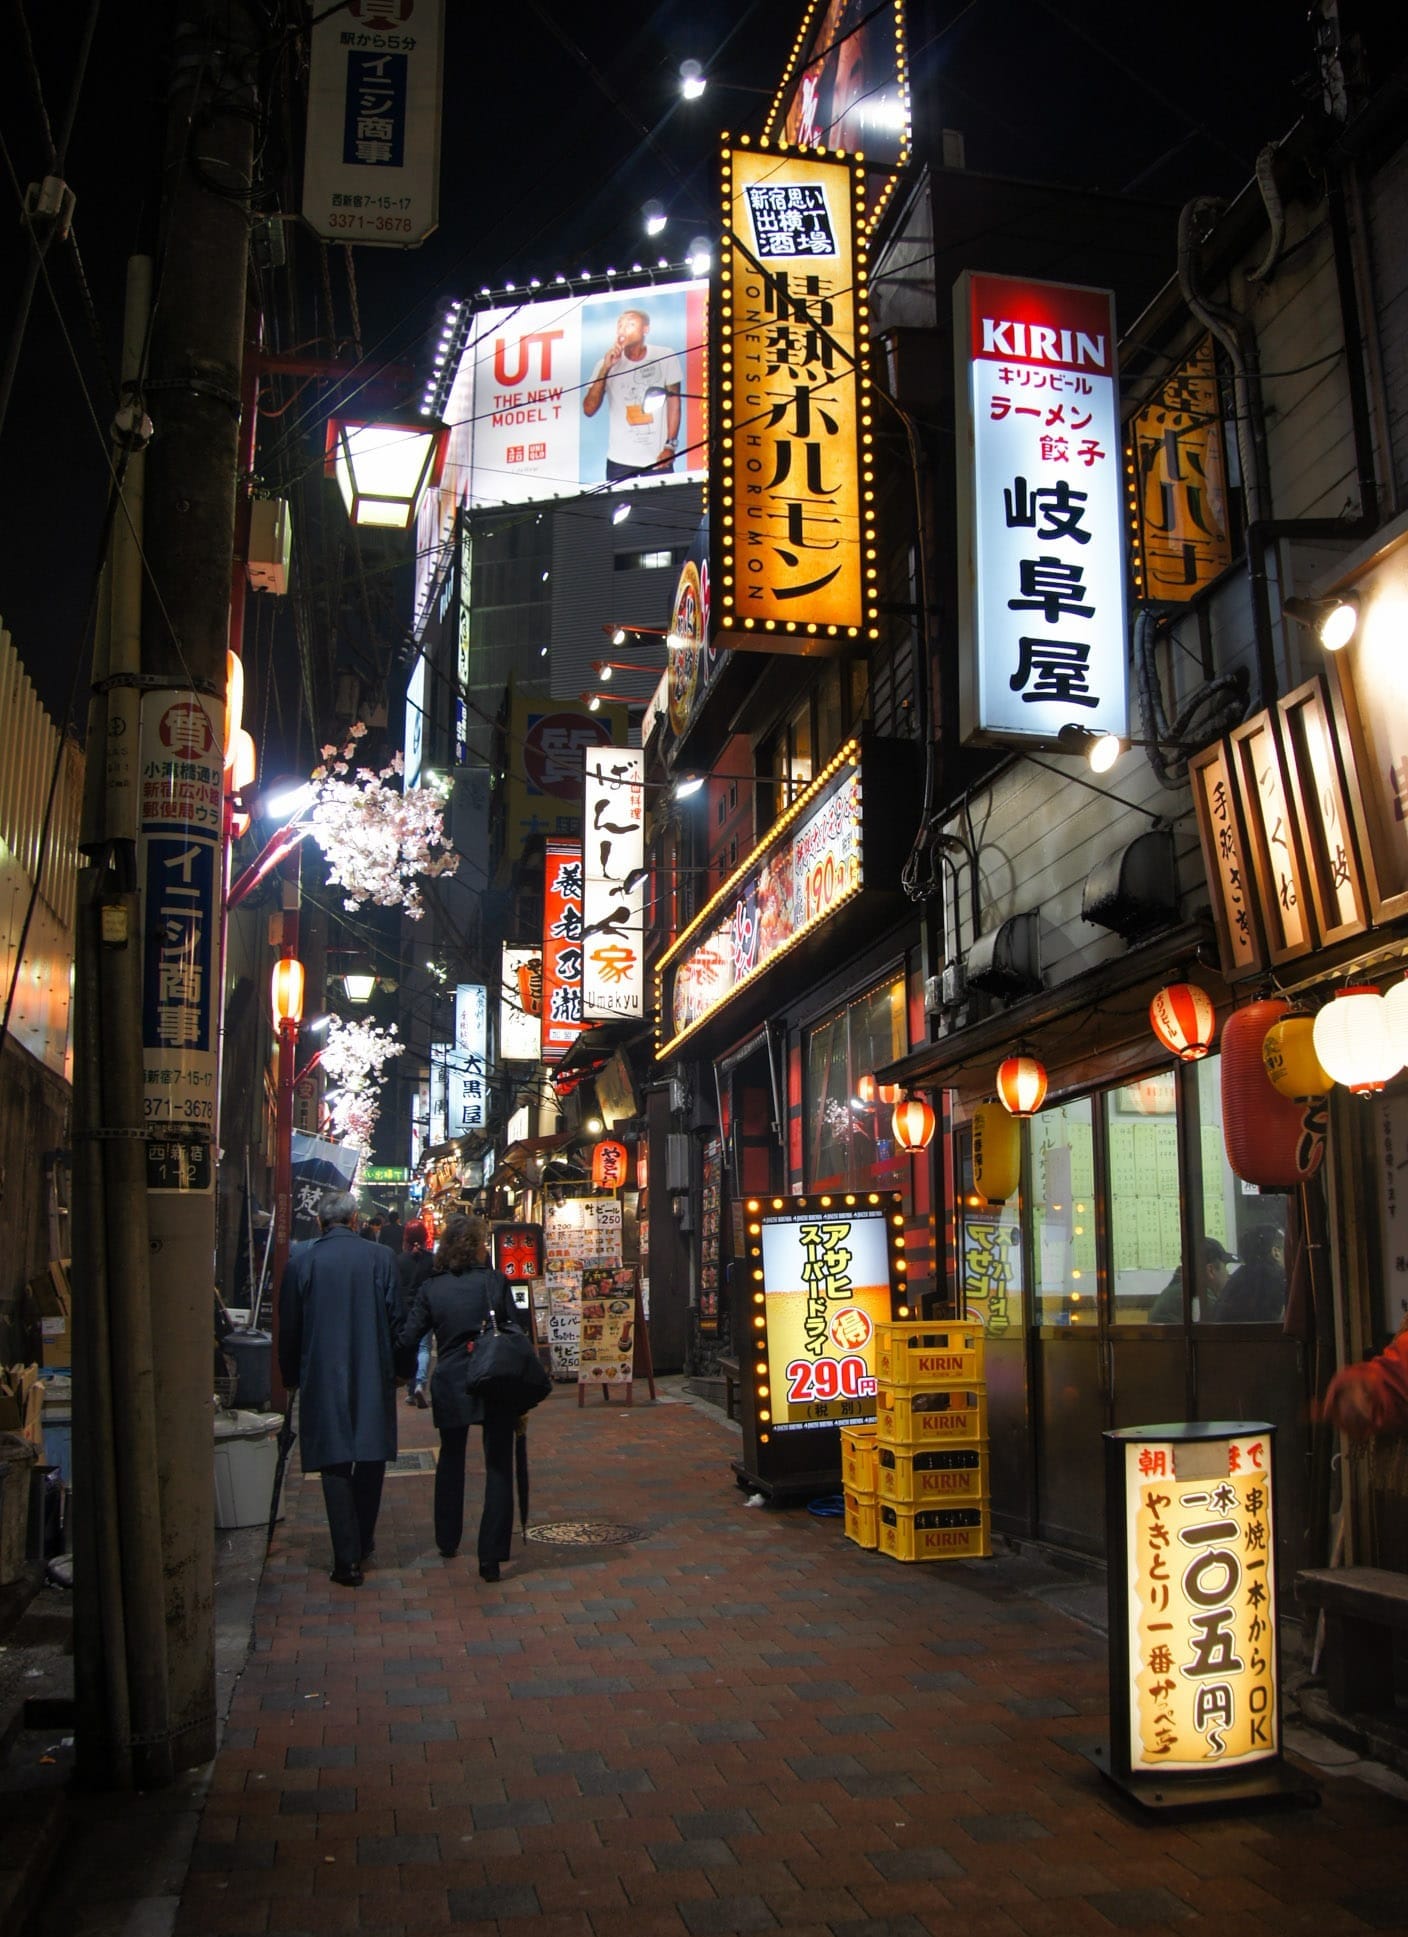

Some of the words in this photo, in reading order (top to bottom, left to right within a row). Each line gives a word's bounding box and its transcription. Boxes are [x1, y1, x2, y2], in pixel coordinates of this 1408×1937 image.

[340, 31, 417, 50] 駅から5分
[354, 54, 395, 164] イニシ商事
[331, 193, 411, 211] 西新宿7-15-17
[749, 188, 823, 210] 新宿思い
[328, 213, 412, 233] 3371-3678
[756, 208, 826, 233] 出横丁
[759, 232, 832, 254] 酒場
[493, 329, 564, 387] UT
[981, 317, 1106, 368] KIRIN
[998, 366, 1093, 396] キリンビール
[493, 393, 522, 409] THE
[527, 386, 564, 404] NEW
[990, 395, 1093, 430] ラーメン
[492, 408, 547, 428] MODEL
[553, 406, 562, 420] T
[529, 443, 545, 453] UNI
[764, 271, 843, 600] 情熱ホルモン
[1039, 434, 1106, 467] 餃子
[529, 452, 545, 461] QLO
[746, 435, 763, 599] HORUMON
[1003, 476, 1100, 709] 岐阜屋
[165, 708, 213, 753] 質
[156, 845, 204, 1047] イニシ商事
[587, 991, 639, 1010] Umakyu
[461, 1054, 482, 1124] 大黒屋
[820, 1222, 852, 1300] アサヒ
[799, 1223, 828, 1356] スーパードライ
[832, 1310, 867, 1349] 得
[786, 1355, 878, 1404] 290円
[919, 1357, 963, 1372] KIRIN
[922, 1415, 967, 1430] KIRIN
[922, 1473, 970, 1490] KIRIN
[1181, 1482, 1239, 1515] 一本
[925, 1531, 969, 1547] KIRIN
